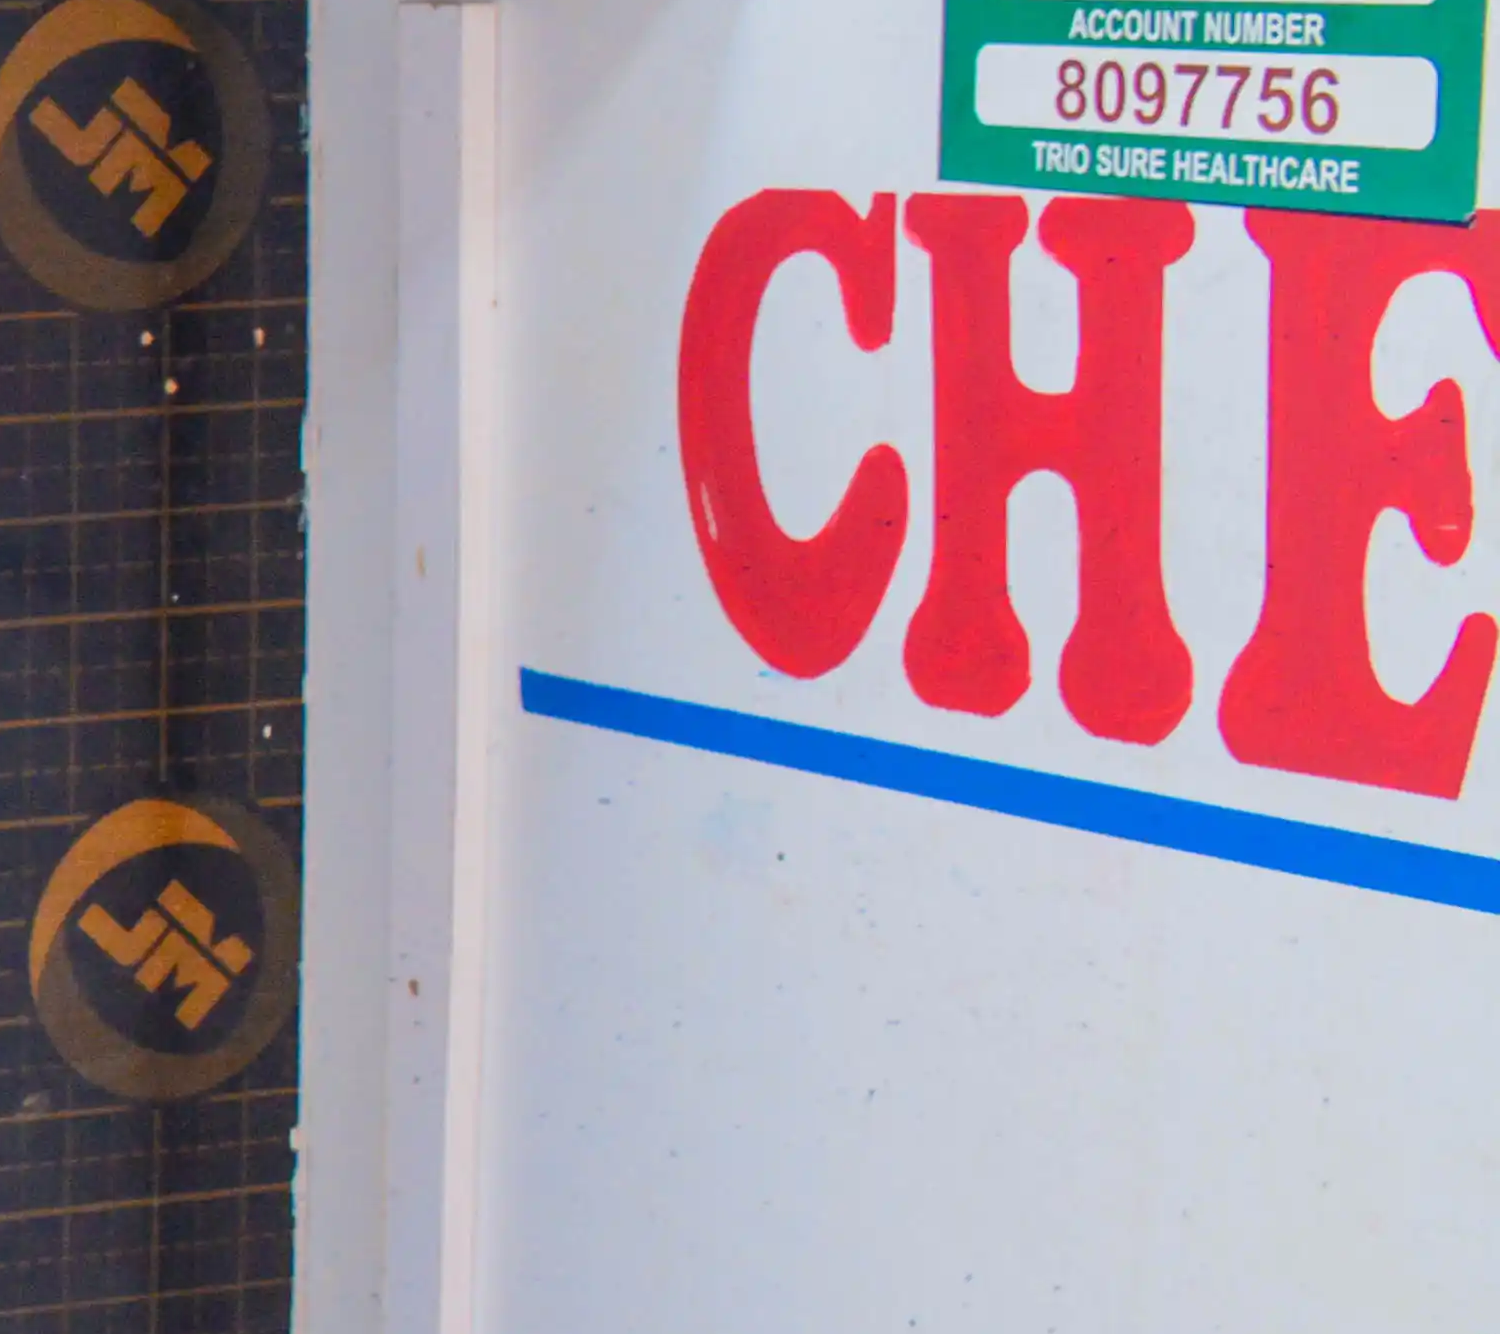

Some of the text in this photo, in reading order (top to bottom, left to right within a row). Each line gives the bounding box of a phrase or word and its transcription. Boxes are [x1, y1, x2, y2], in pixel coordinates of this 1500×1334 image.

[1067, 7, 1326, 47] ACCOUNT NUMBER
[1052, 57, 1341, 137] 8097756
[1031, 140, 1361, 195] TRIO SURE HEALTHCARE
